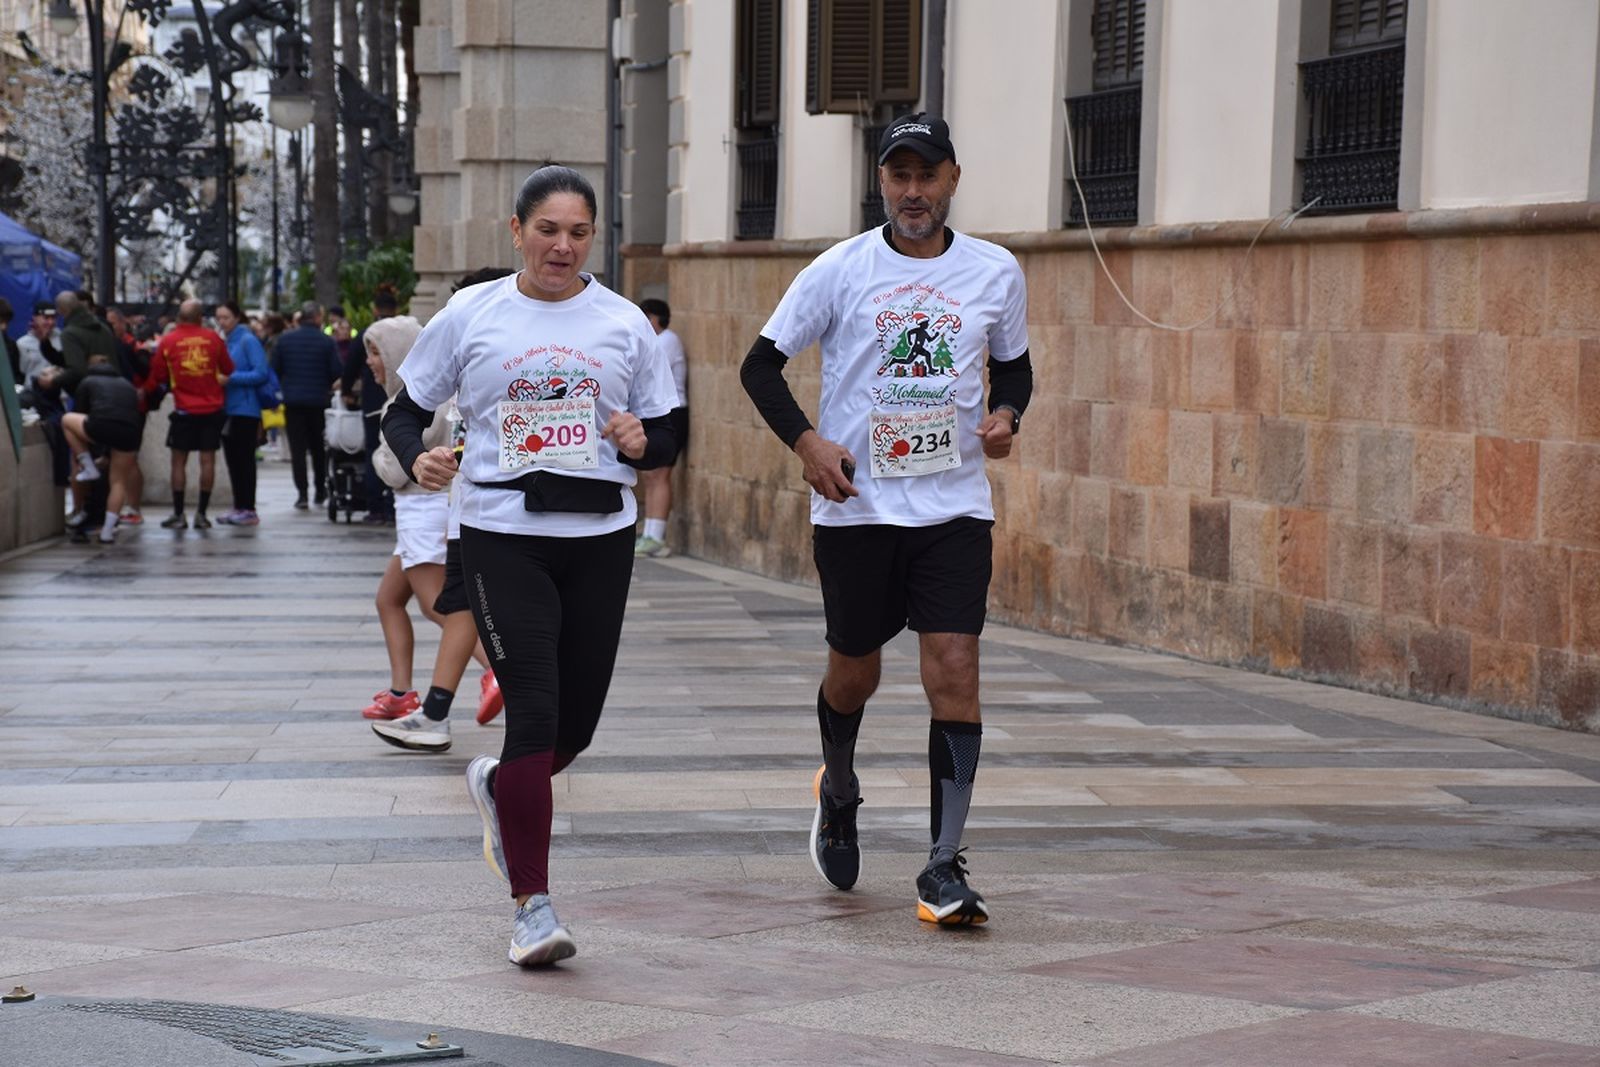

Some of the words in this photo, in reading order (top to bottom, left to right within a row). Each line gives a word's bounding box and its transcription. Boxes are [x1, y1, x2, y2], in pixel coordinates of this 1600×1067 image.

[882, 383, 949, 400] Mohamed
[541, 424, 587, 447] 209
[911, 429, 951, 454] 234
[484, 614, 494, 631] on
[490, 632, 506, 661] keep
